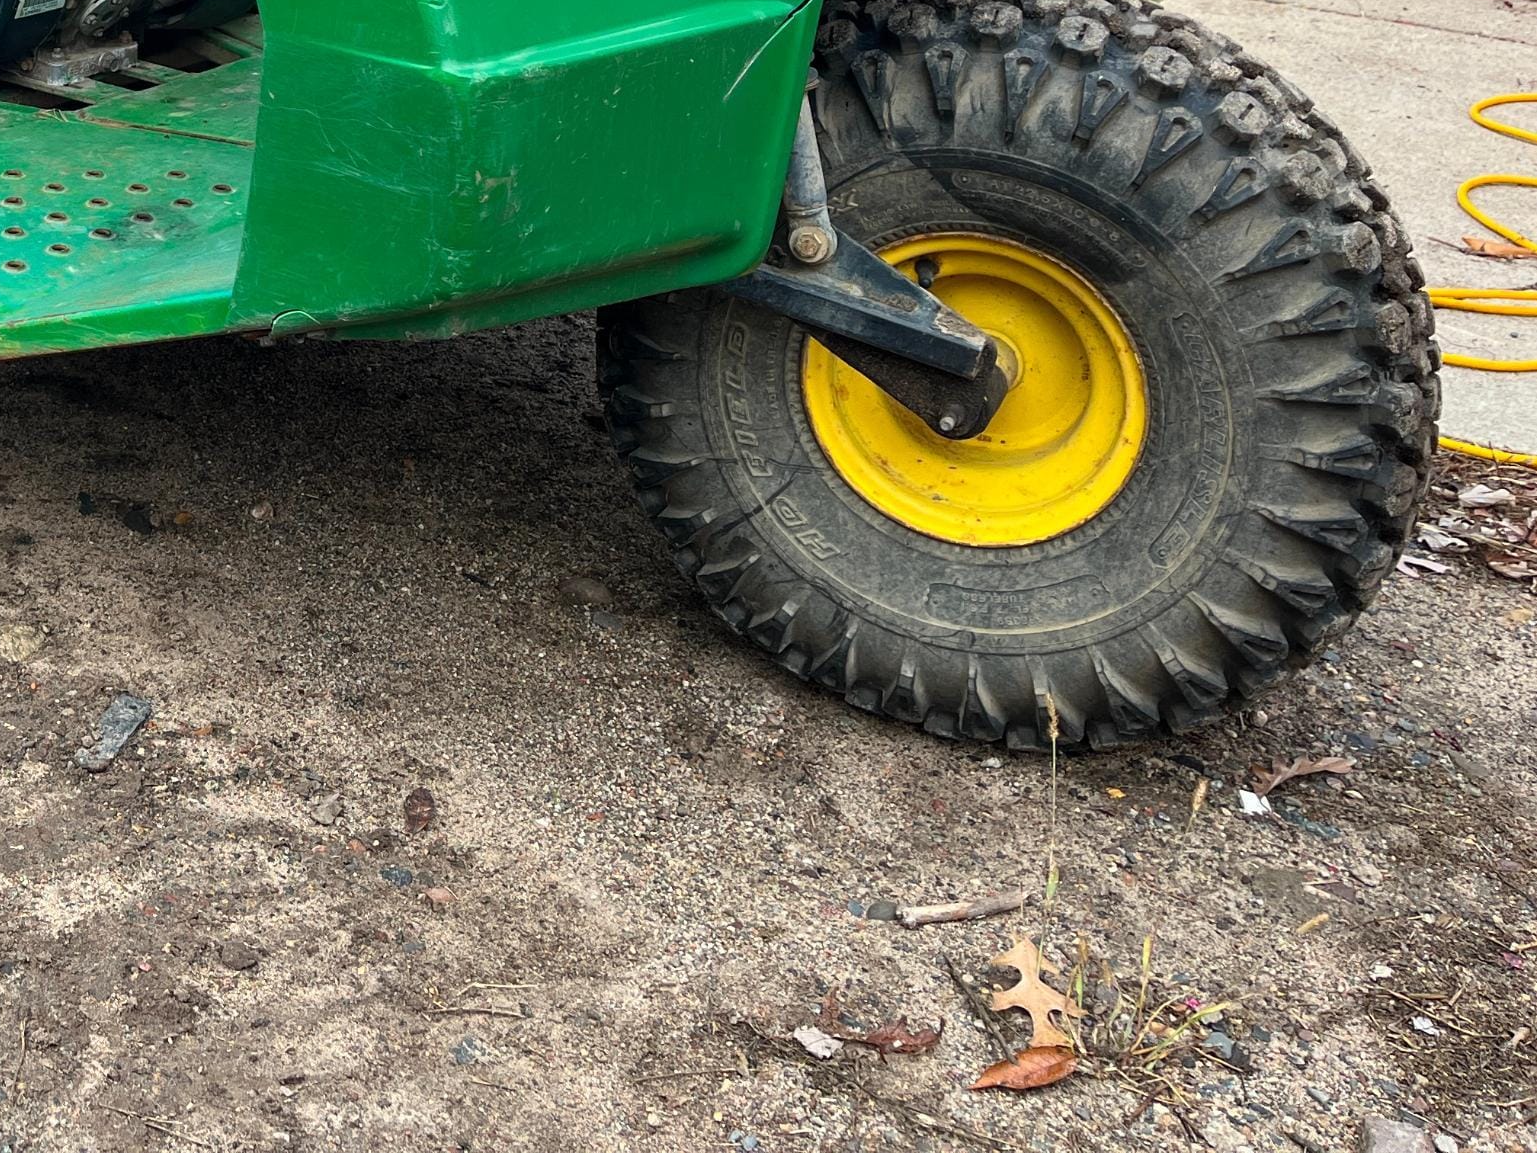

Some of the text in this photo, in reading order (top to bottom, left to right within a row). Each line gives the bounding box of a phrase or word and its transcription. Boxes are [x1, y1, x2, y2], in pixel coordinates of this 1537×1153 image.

[723, 322, 841, 561] HD FIELD
[1163, 333, 1227, 548] CARLISLE
